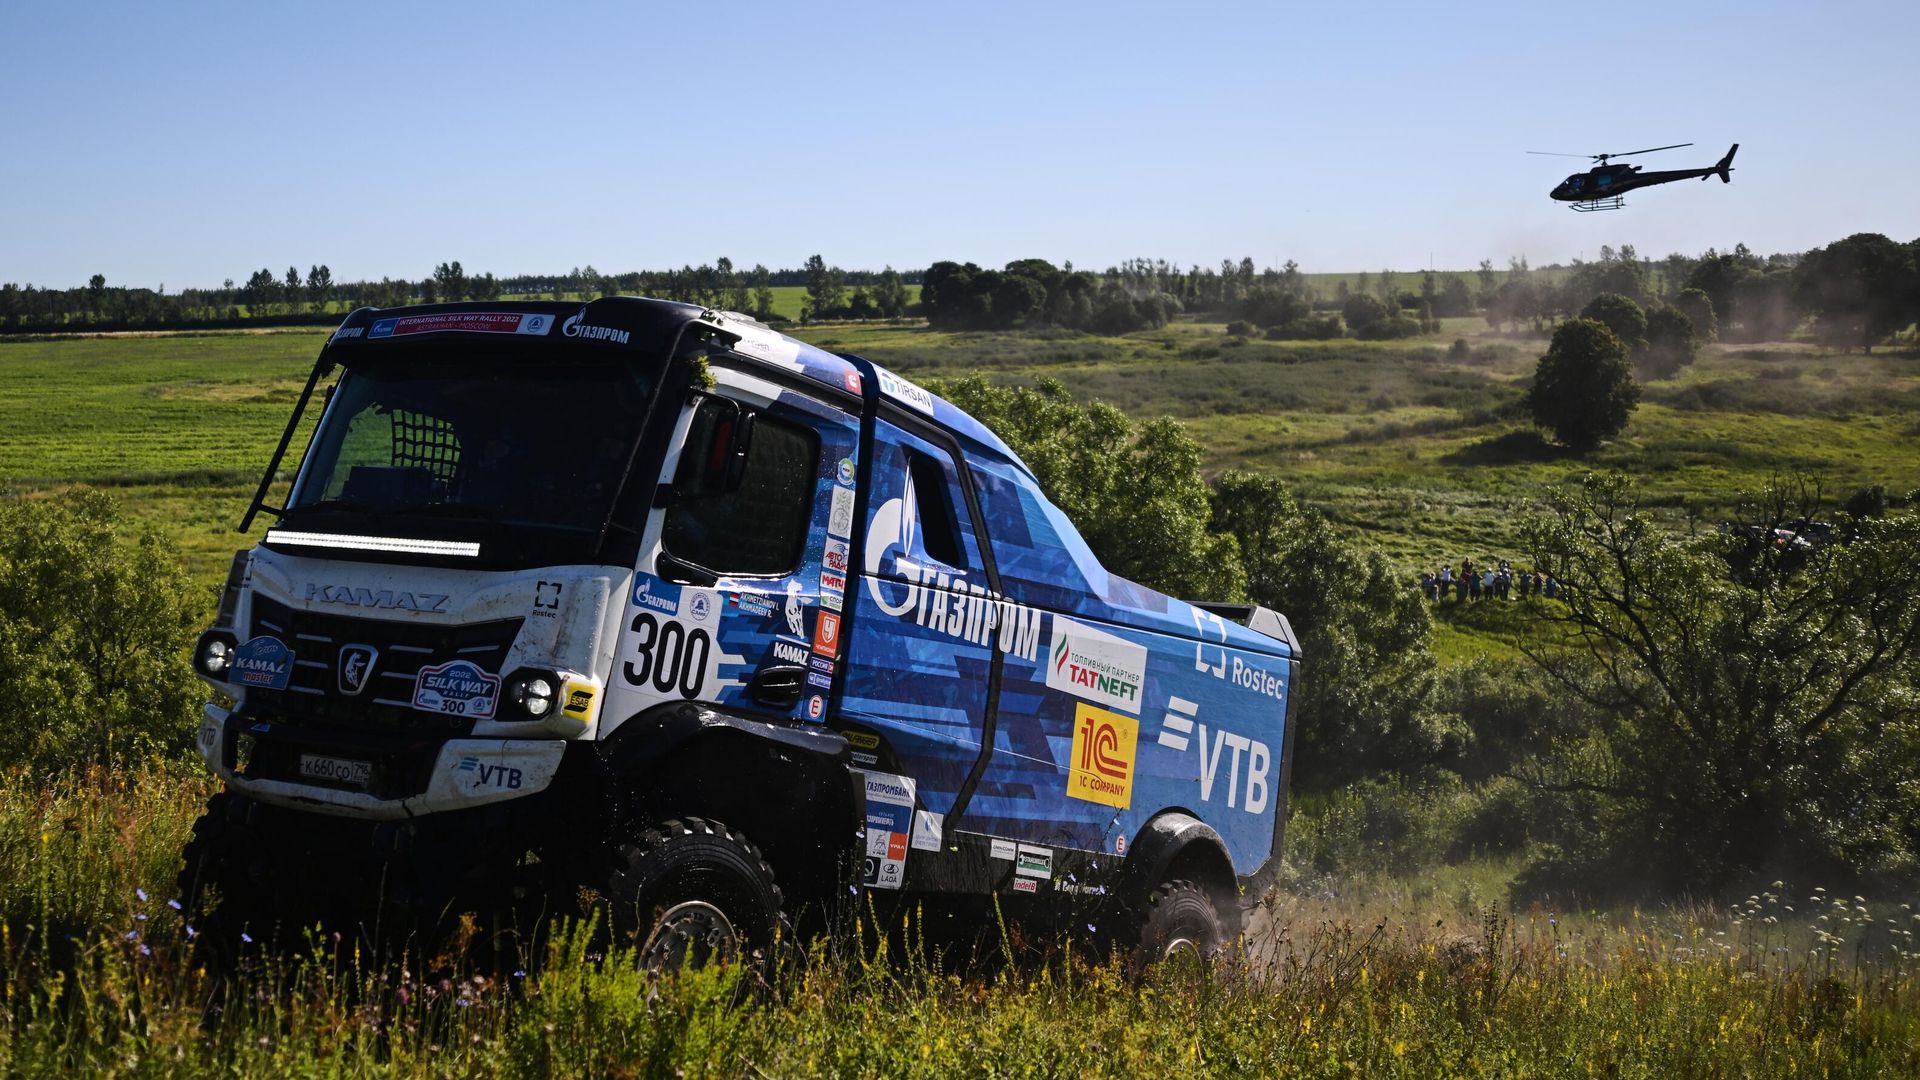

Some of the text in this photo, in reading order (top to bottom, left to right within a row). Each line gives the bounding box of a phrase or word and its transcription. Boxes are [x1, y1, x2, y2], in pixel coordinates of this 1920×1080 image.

[399, 316, 447, 326] INTERNATIONAL
[463, 314, 478, 322] WAY
[460, 322, 490, 330] MOSCOW
[579, 325, 630, 344] ГАЗПРОМ
[305, 583, 449, 613] KAMAZ
[648, 595, 677, 612] GAZPROM
[532, 609, 557, 619] Rostec
[916, 569, 1041, 662] ГАЗПРОМ
[623, 612, 711, 700] 300
[774, 642, 809, 665] KAMAZ
[236, 657, 286, 674] KAMAZ
[449, 670, 471, 679] 2022
[1071, 652, 1140, 683] ТОПЛИВНЫЙ ПАРТНЕР
[425, 676, 492, 694] SILK WAY
[1070, 664, 1138, 701] TATNEFT
[1232, 657, 1284, 700] Rostec
[441, 699, 465, 714] 300
[570, 696, 589, 708] ESAB
[1081, 718, 1127, 780] 1C
[479, 764, 522, 789] VTB
[1199, 724, 1271, 815] VTB
[1079, 775, 1125, 797] 1C COMPANY
[881, 875, 897, 883] LADA
